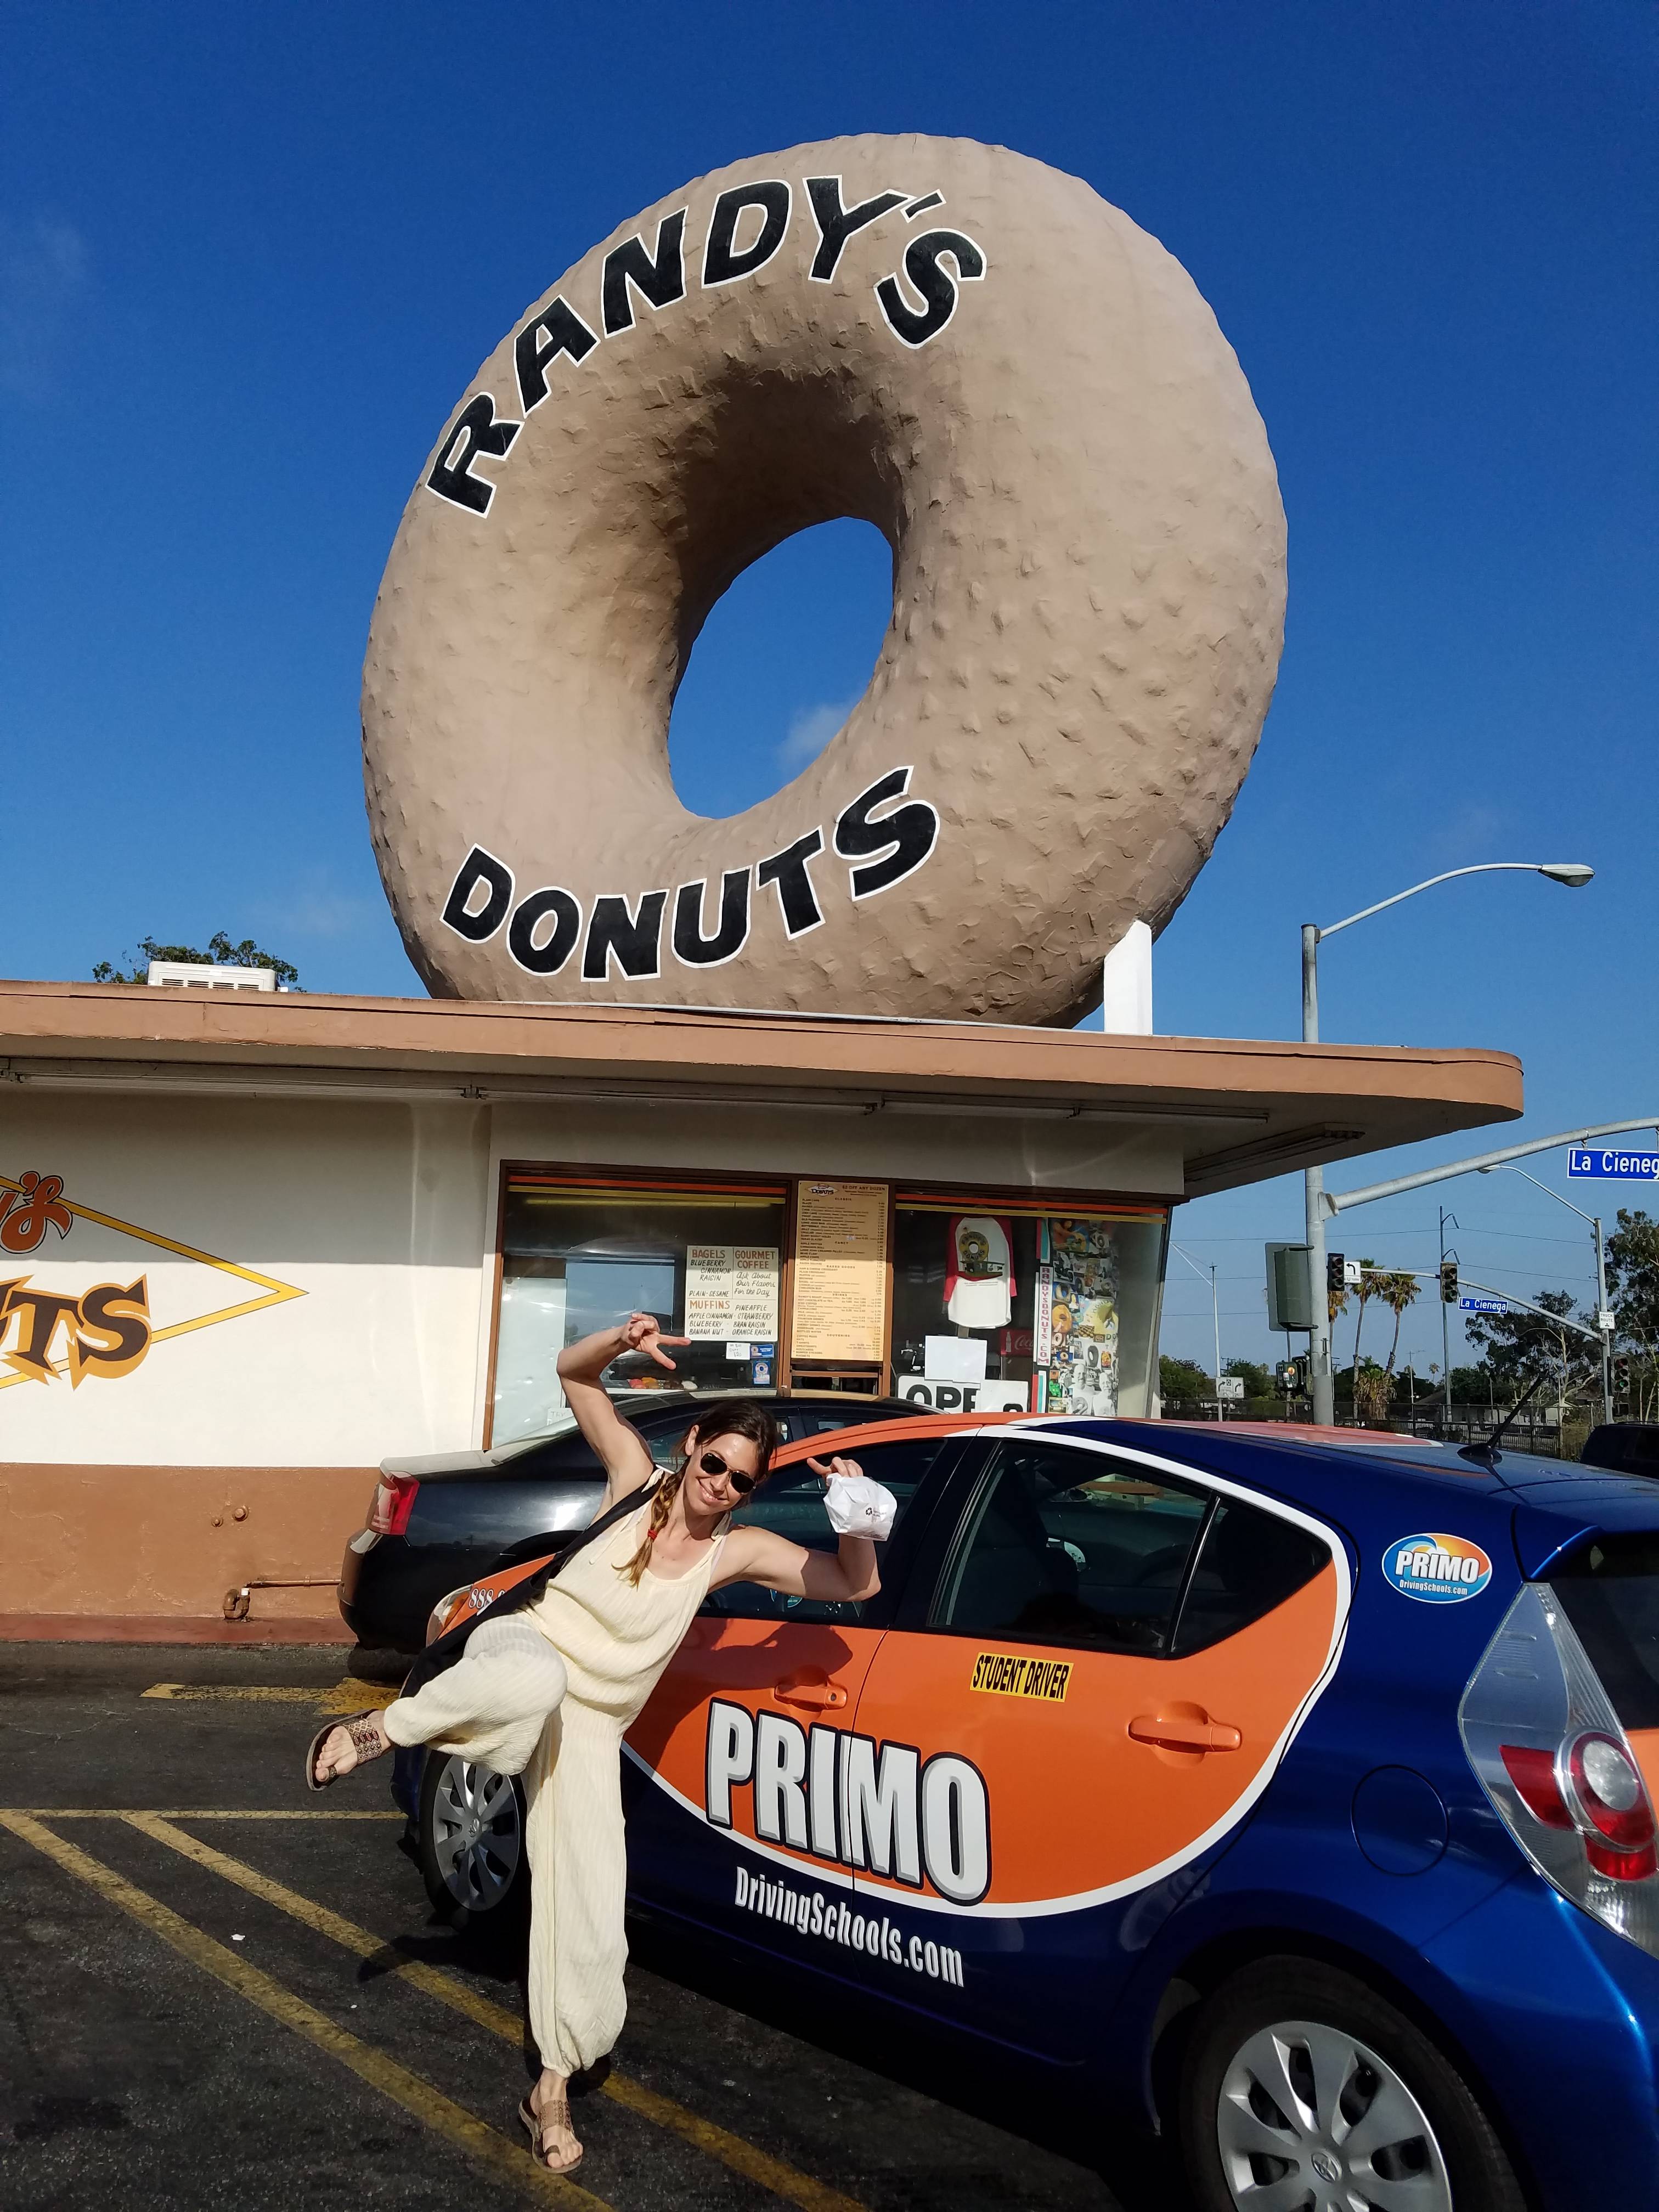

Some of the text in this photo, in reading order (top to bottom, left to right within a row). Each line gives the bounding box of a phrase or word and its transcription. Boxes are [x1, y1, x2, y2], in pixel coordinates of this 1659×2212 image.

[425, 174, 987, 518] RANDY'S
[439, 765, 940, 982] DONUTS
[1571, 1150, 1591, 1171] La
[692, 1249, 725, 1259] BAGELS
[735, 1250, 776, 1260] GOURMET
[737, 1260, 770, 1269] COFFEE
[757, 1289, 770, 1298] Day
[690, 1300, 730, 1309] MUFFINS
[1460, 1299, 1506, 1312] La Cienega
[1395, 1550, 1480, 1584] PRIMO
[1400, 1579, 1468, 1596] DrivingSchools.com
[973, 1655, 1069, 1699] STUDENT DRIVER
[705, 1697, 991, 1907] PRIMO
[735, 1866, 964, 1987] DrivingSchools.com
